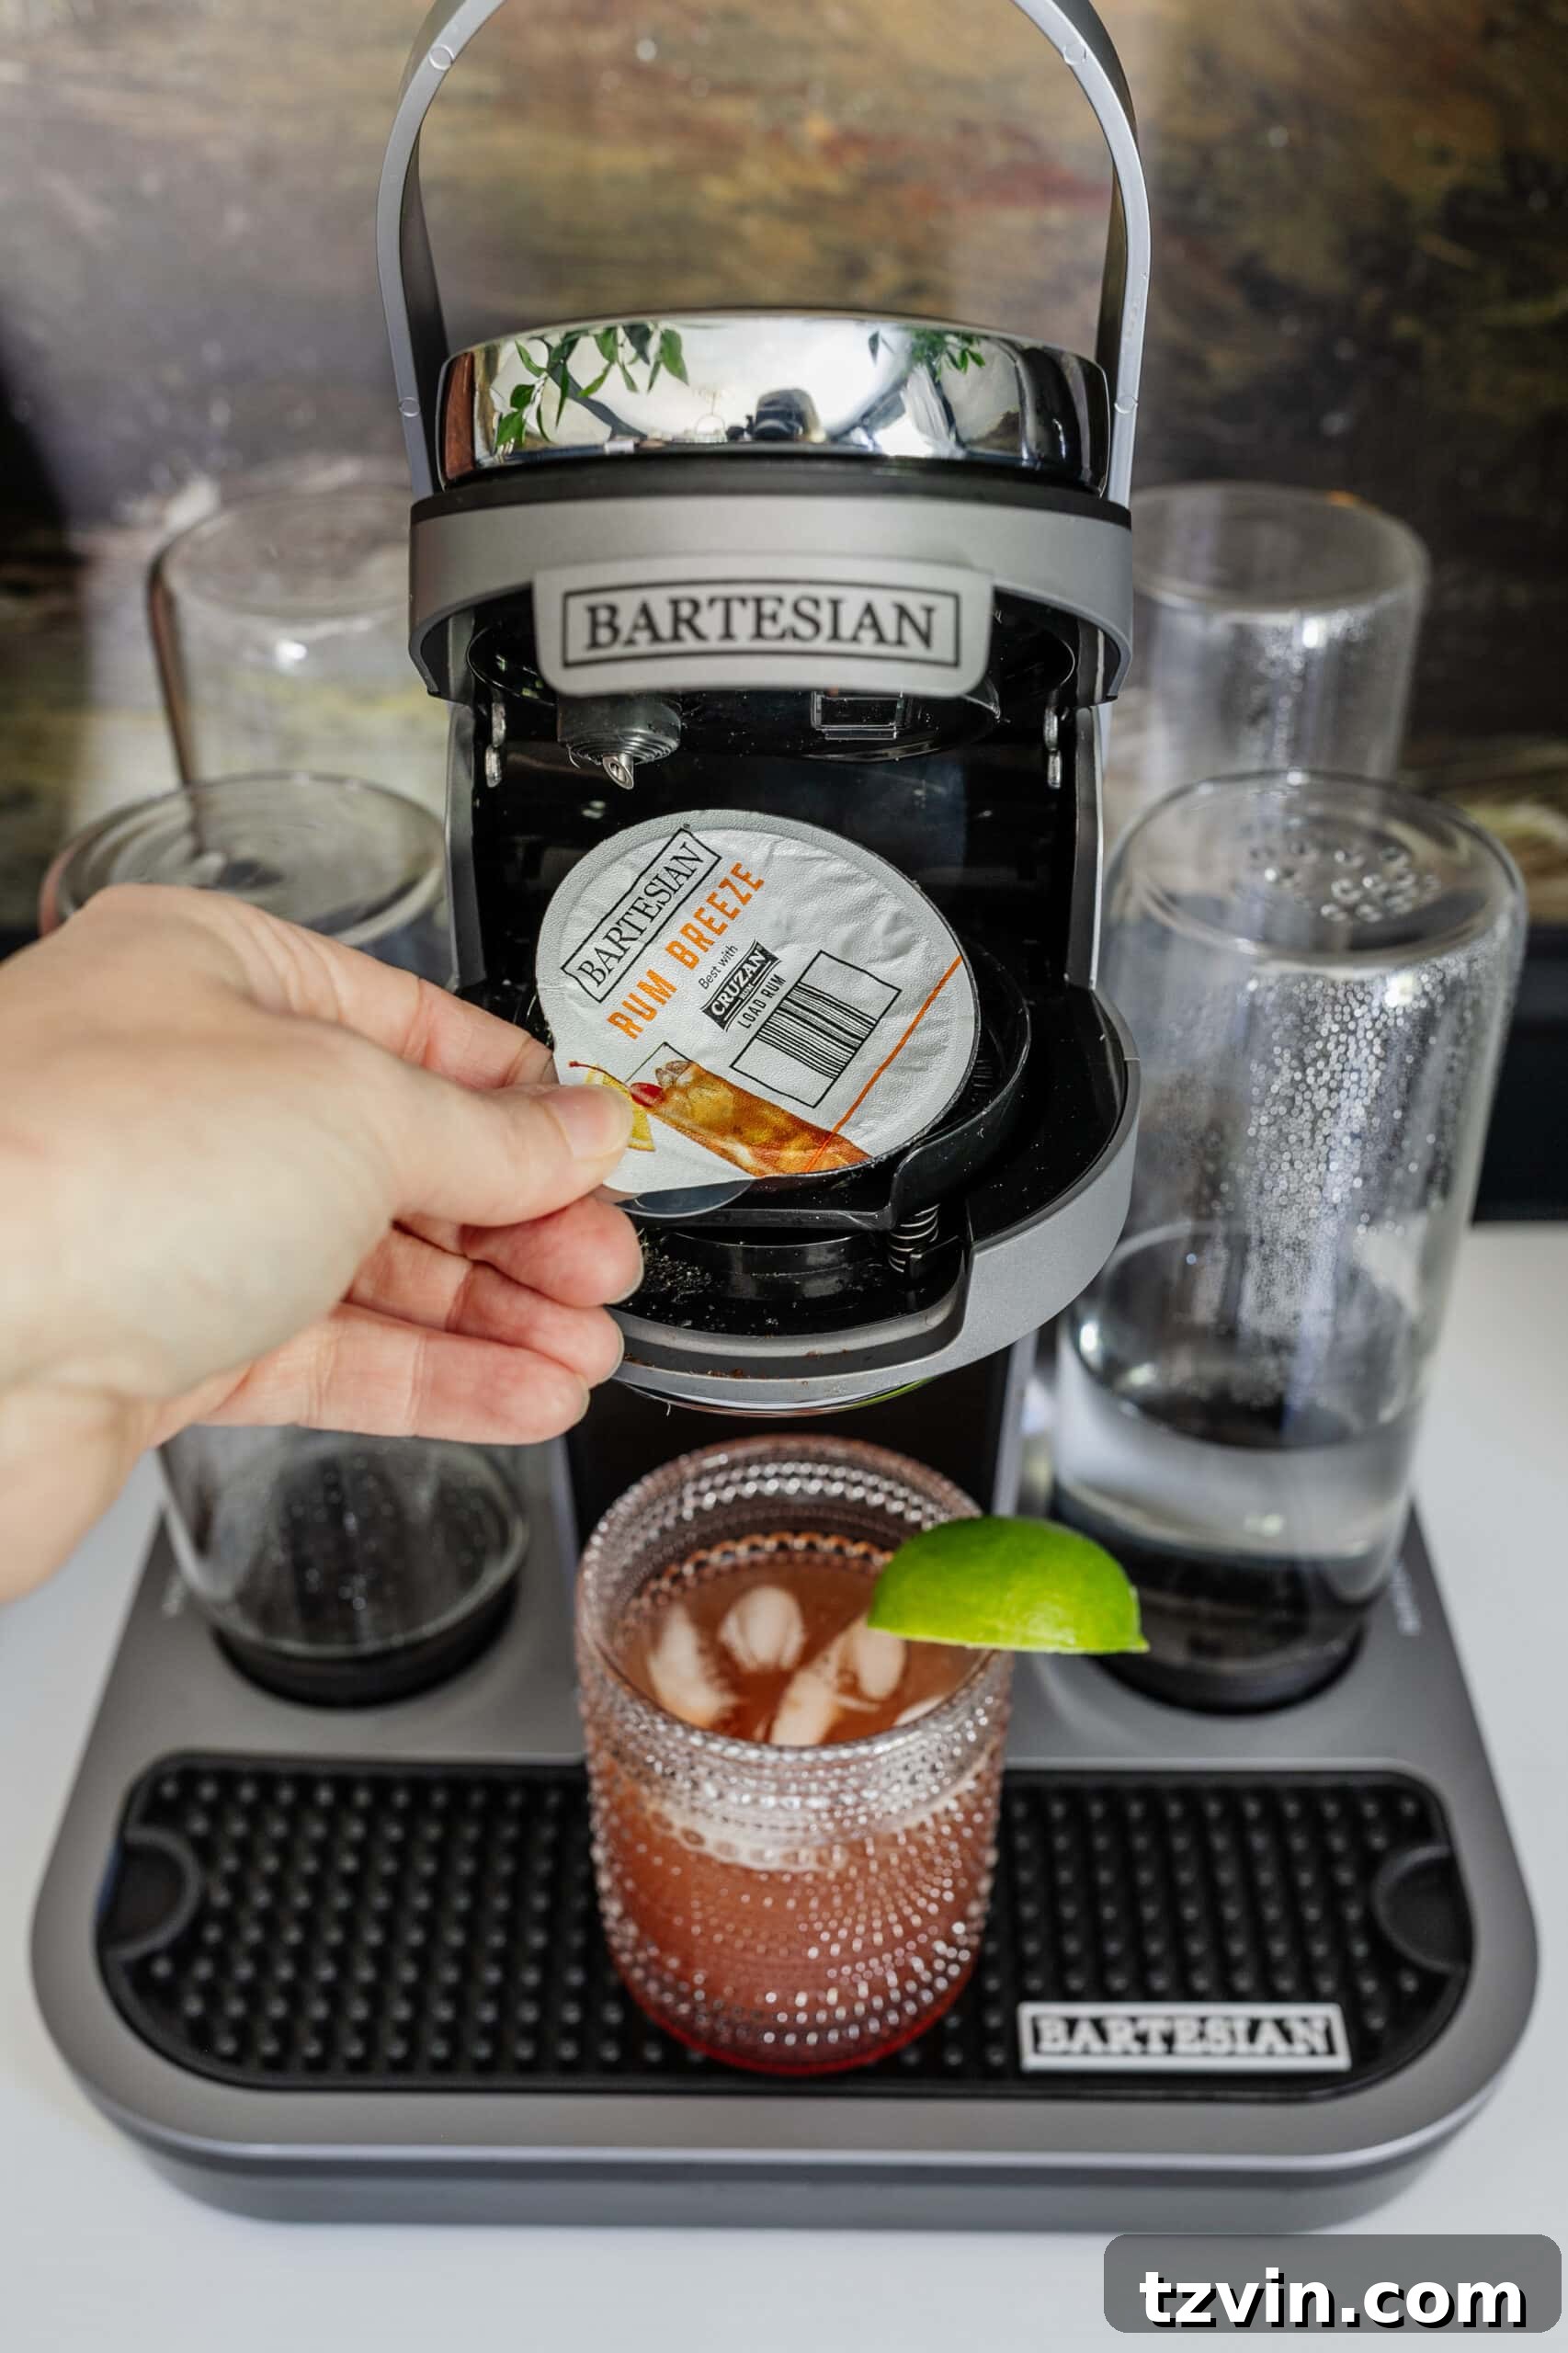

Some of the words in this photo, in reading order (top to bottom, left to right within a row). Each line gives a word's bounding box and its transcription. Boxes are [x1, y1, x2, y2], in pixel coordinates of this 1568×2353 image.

[585, 595, 937, 651] BARTESIAN
[576, 841, 706, 987] BARTESIAN
[606, 969, 677, 1040] RUM
[665, 861, 766, 971] BREEZE
[699, 965, 722, 990] Best
[718, 945, 739, 967] with
[710, 949, 767, 1016] CRUZAN
[737, 999, 767, 1029] LOAD
[760, 973, 787, 999] RUM
[1036, 2015, 1331, 2055] BARTESIAN
